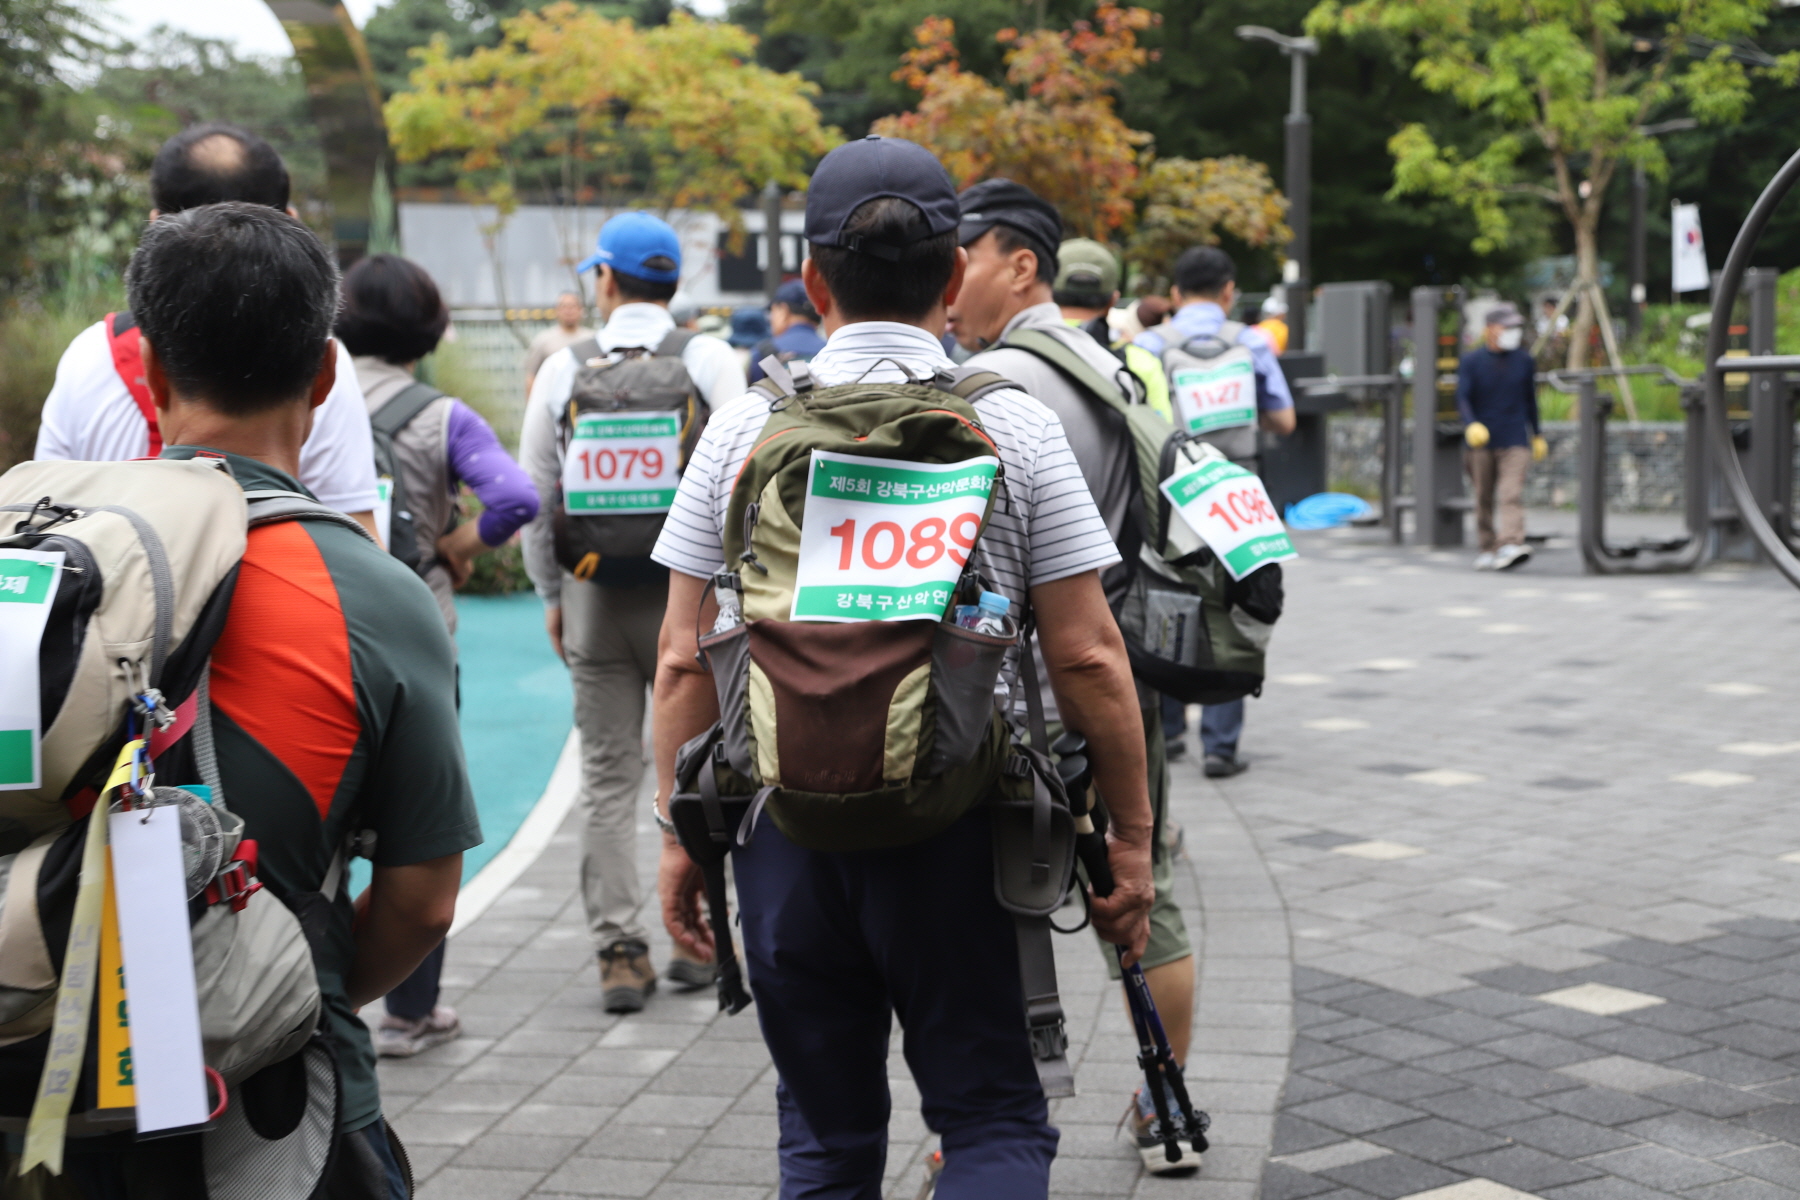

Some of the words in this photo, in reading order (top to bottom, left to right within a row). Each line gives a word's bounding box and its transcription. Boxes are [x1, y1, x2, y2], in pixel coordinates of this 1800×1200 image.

[577, 448, 664, 481] 1079
[829, 475, 872, 495] 제5회
[830, 512, 982, 570] 1089
[837, 589, 951, 611] 강북구산악연
